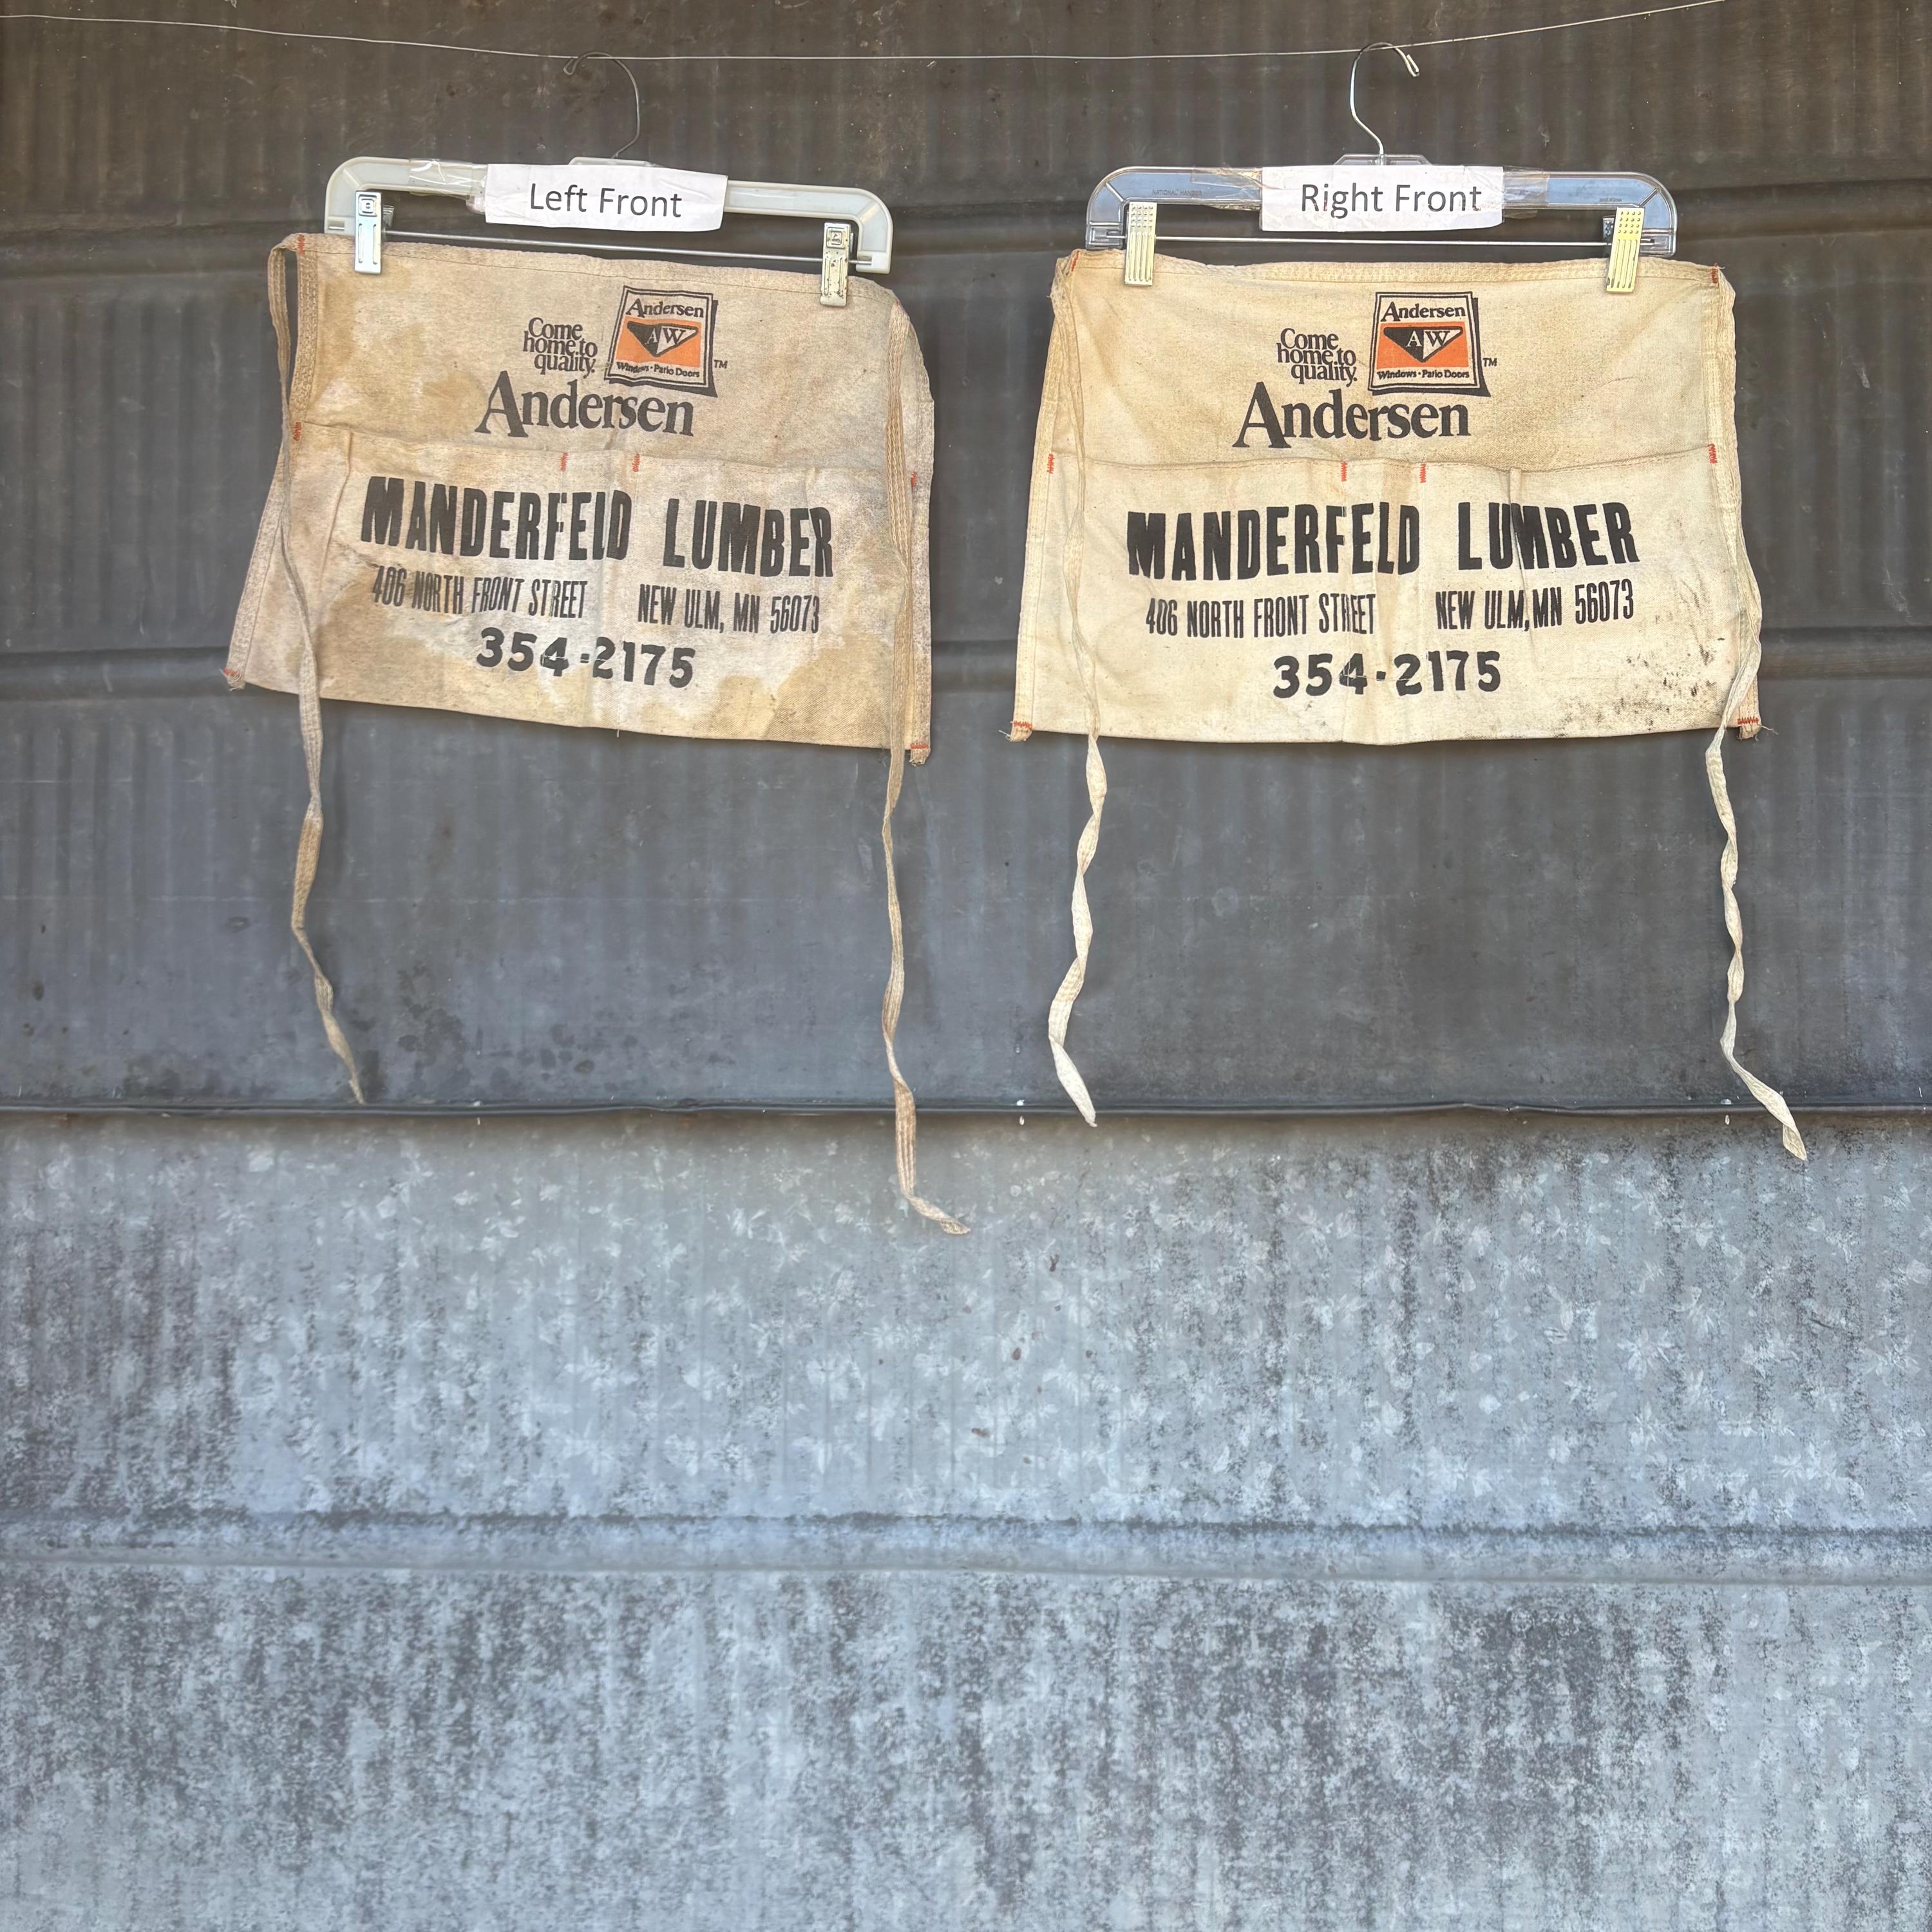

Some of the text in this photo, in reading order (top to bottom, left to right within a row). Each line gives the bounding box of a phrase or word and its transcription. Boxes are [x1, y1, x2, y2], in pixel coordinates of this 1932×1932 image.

[531, 183, 682, 218] Left Front
[1302, 182, 1482, 219] Right Front
[625, 298, 704, 318] Andersen
[1380, 301, 1466, 322] Andersen
[528, 317, 583, 340] Come
[1280, 327, 1339, 350] Come
[522, 330, 598, 357] home to
[1276, 342, 1356, 366] home to
[534, 352, 596, 379] quality.
[654, 364, 674, 375] Patio
[676, 367, 700, 377] Doors
[714, 359, 728, 369] TM
[1291, 361, 1358, 388] quality.
[1376, 369, 1470, 380] Windows Patio Doors
[1482, 357, 1498, 367] TM
[474, 370, 694, 438] Andersen
[1232, 381, 1472, 448] Andersen
[663, 498, 833, 577] LUMBER
[1127, 502, 1640, 581] MANDERFELD LUMBER
[372, 565, 588, 619] 406 NORTH FRONT STREET
[1435, 591, 1475, 630] NEW
[1532, 587, 1562, 629] MN
[1575, 578, 1634, 624] 56073
[638, 583, 820, 634] NEW ULM, MN 56073
[1146, 598, 1178, 636] 406
[1187, 600, 1244, 638] NORTH
[1254, 594, 1309, 638] FRONT
[477, 627, 696, 688] 354-2175
